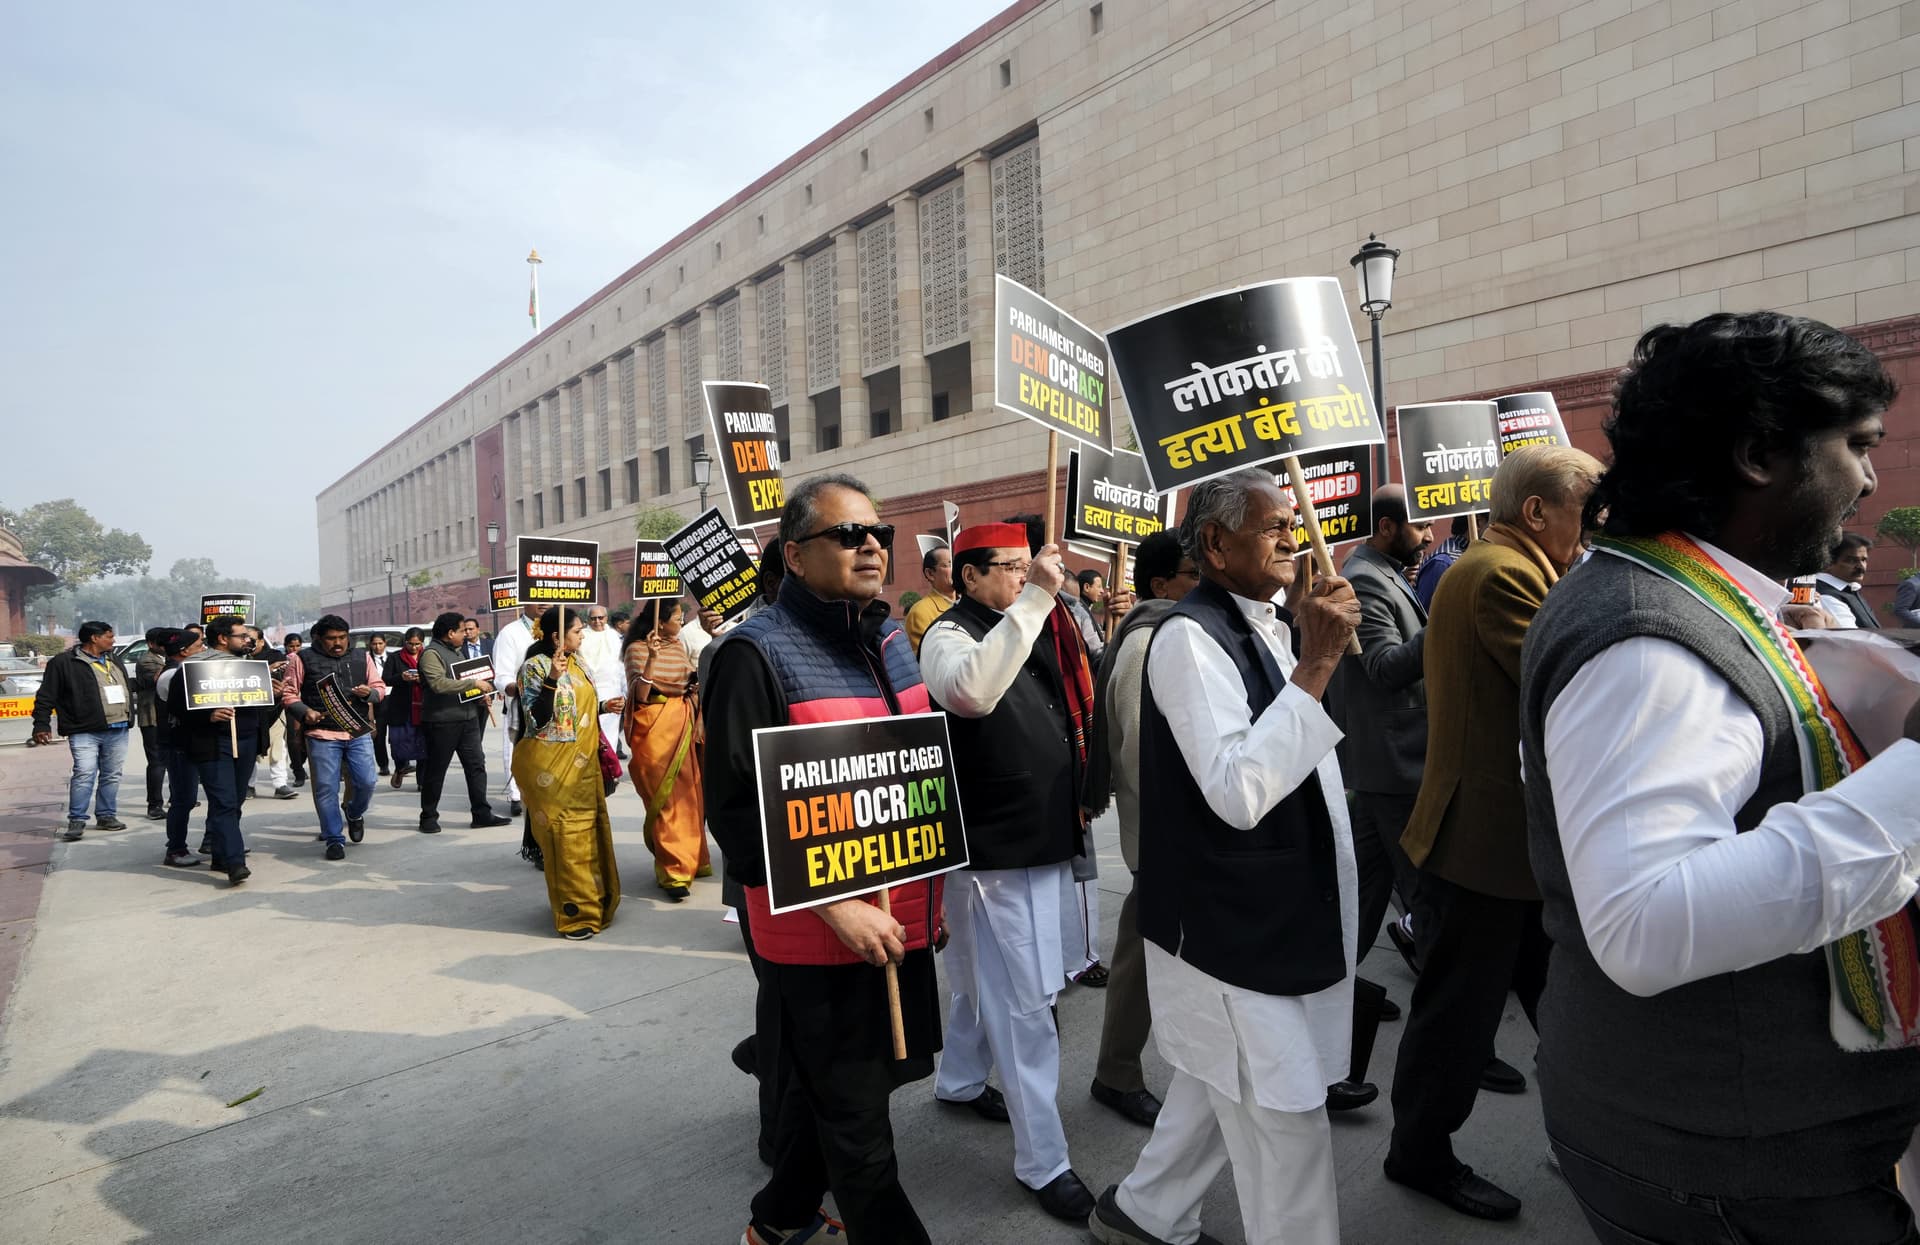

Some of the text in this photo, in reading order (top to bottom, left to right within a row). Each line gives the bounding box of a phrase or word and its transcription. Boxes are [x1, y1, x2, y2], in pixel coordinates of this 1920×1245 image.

[1009, 306, 1104, 377] PARLIAMENT CAGED
[1010, 333, 1105, 408] DEMOCRACY
[1163, 335, 1344, 413] लोकतंत्र की
[1019, 372, 1100, 437] EXPELLED!
[1158, 383, 1371, 470] हत्या बंद करो!
[732, 440, 781, 474] DEMOC
[1334, 460, 1355, 475] MPs
[1422, 439, 1499, 474] लोकतंत्र की
[1093, 476, 1142, 509] लोकतंत्र
[1337, 503, 1350, 514] OF
[1414, 481, 1456, 509] हत्या
[1457, 474, 1481, 503] बंद
[669, 515, 722, 559] DEMOCRACY
[1084, 504, 1113, 530] हत्या
[1113, 509, 1134, 535] बंद
[529, 563, 591, 578] SUSPENDED
[640, 563, 682, 578] DEMOCRAC
[676, 545, 706, 572] UNDER
[683, 567, 700, 584] WE
[696, 548, 727, 575] WON'T
[724, 540, 741, 557] BE
[701, 560, 737, 588] CAGED!
[529, 587, 591, 599] DEMOCRACY?
[643, 579, 679, 594] EXPELLED!
[700, 566, 757, 608] WHY PM & HM
[713, 582, 757, 615] IS SILENT?
[779, 745, 943, 791] PARLIAMENT CAGED
[786, 776, 947, 841] DEMOCRACY
[806, 821, 946, 888] EXPELLED!
